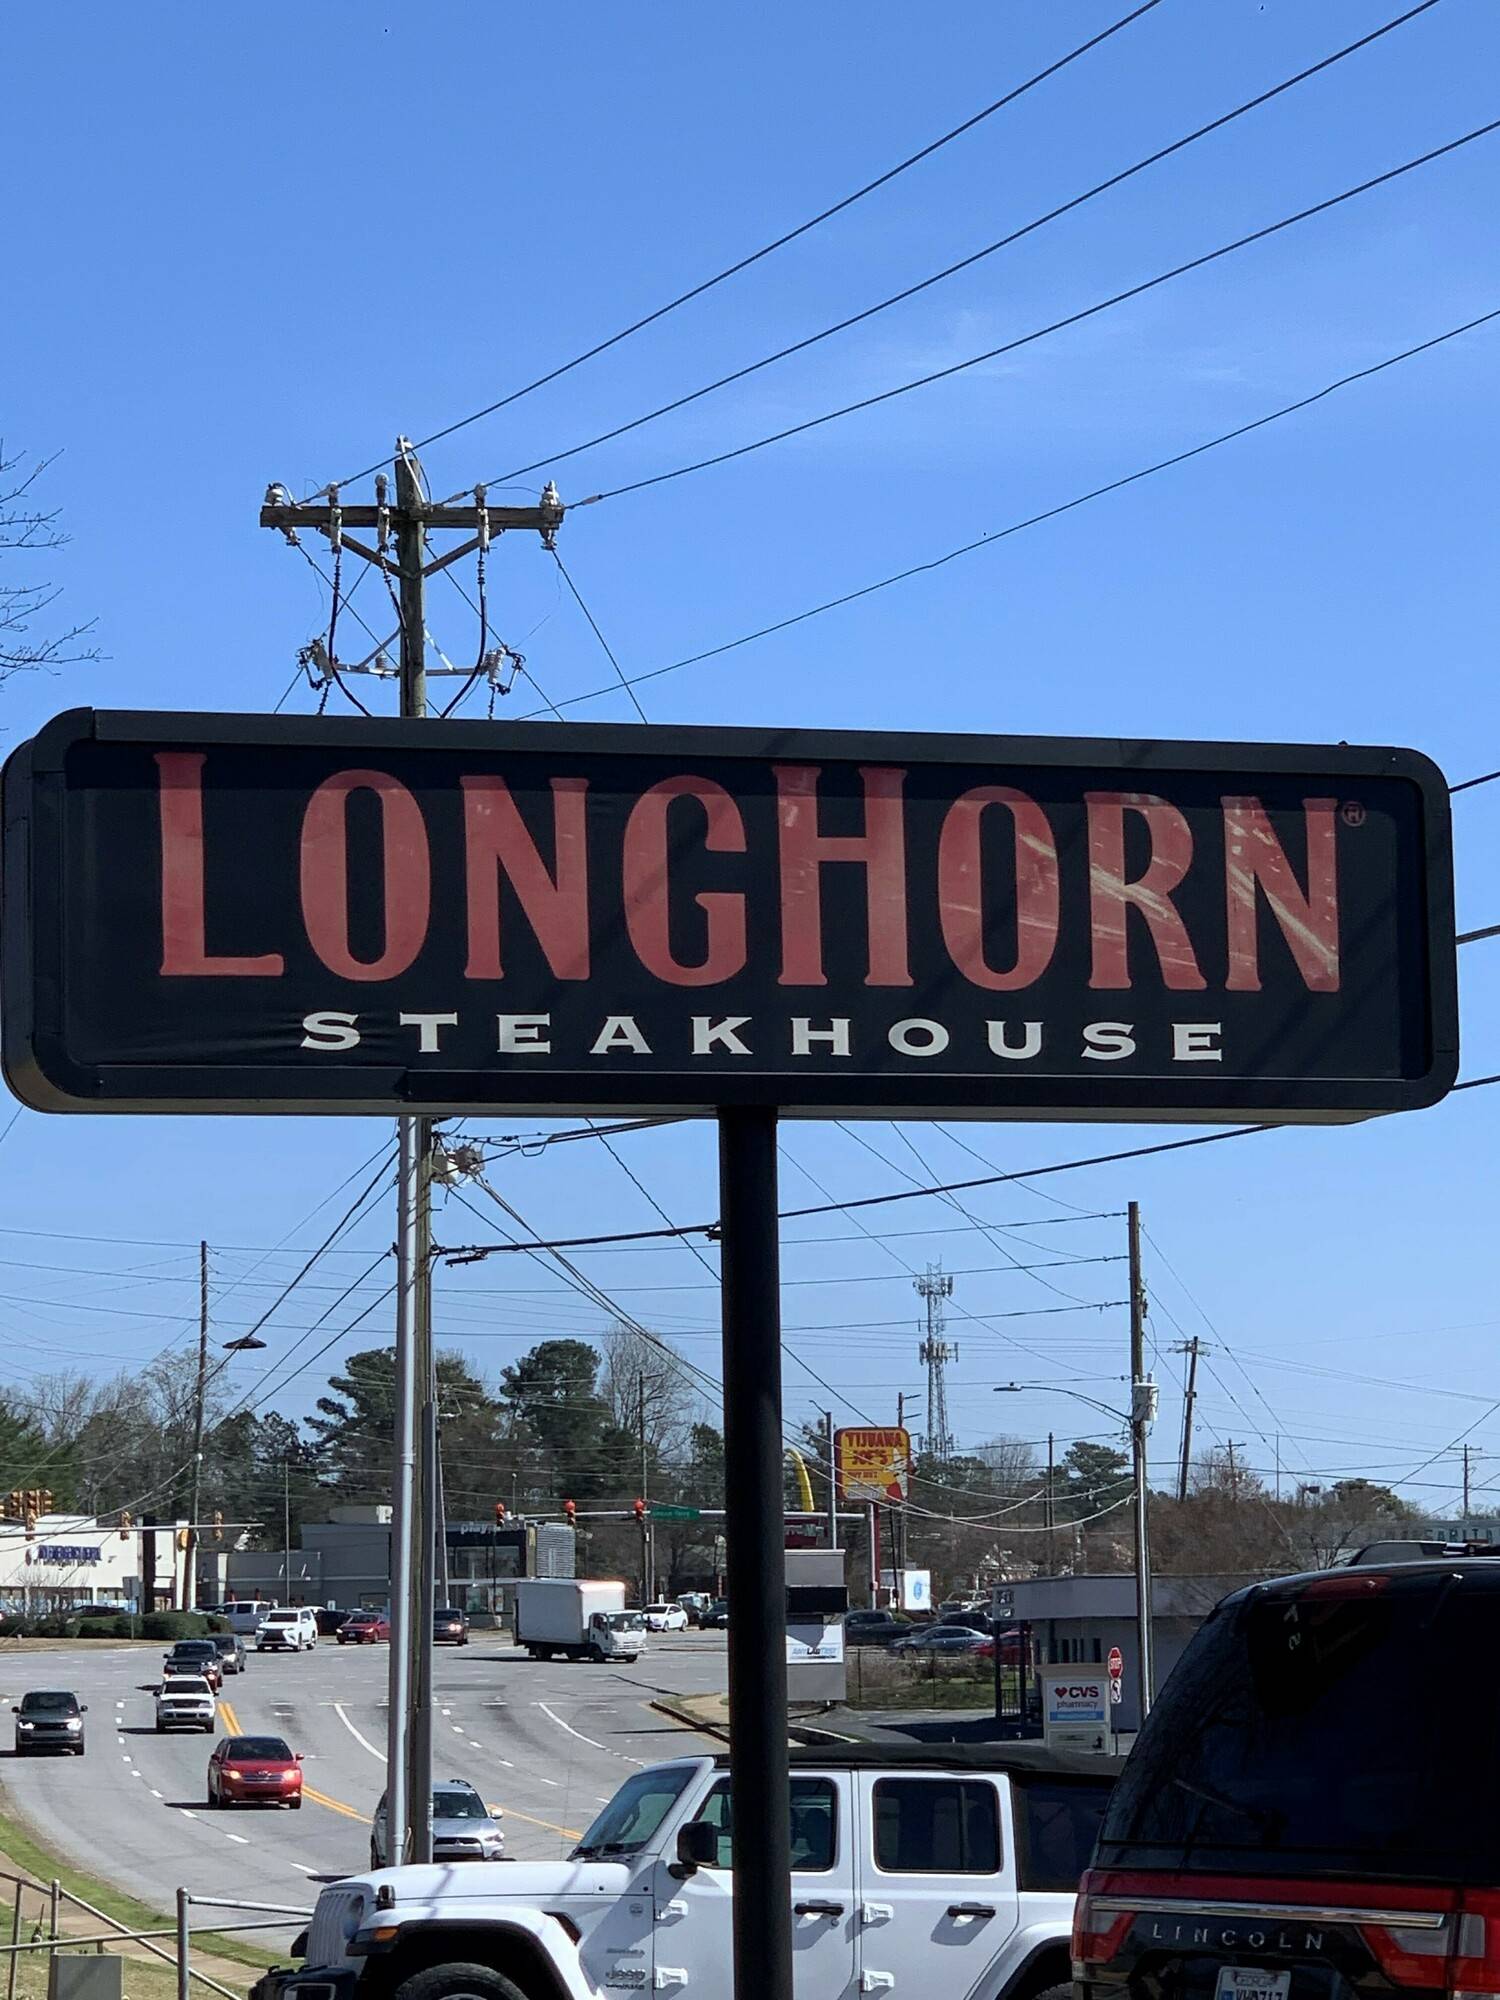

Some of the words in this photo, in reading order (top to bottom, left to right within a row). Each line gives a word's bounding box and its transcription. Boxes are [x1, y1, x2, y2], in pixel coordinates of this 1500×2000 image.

[153, 752, 1340, 993] LONGHORN
[301, 1011, 1223, 1062] STEAKHOUSE
[845, 1432, 904, 1447] TIJUANA
[1109, 1658, 1122, 1669] STOP
[1069, 1686, 1099, 1698] CVS
[1057, 1702, 1098, 1711] pharmacy
[1152, 1923, 1323, 1949] LINCOLN
